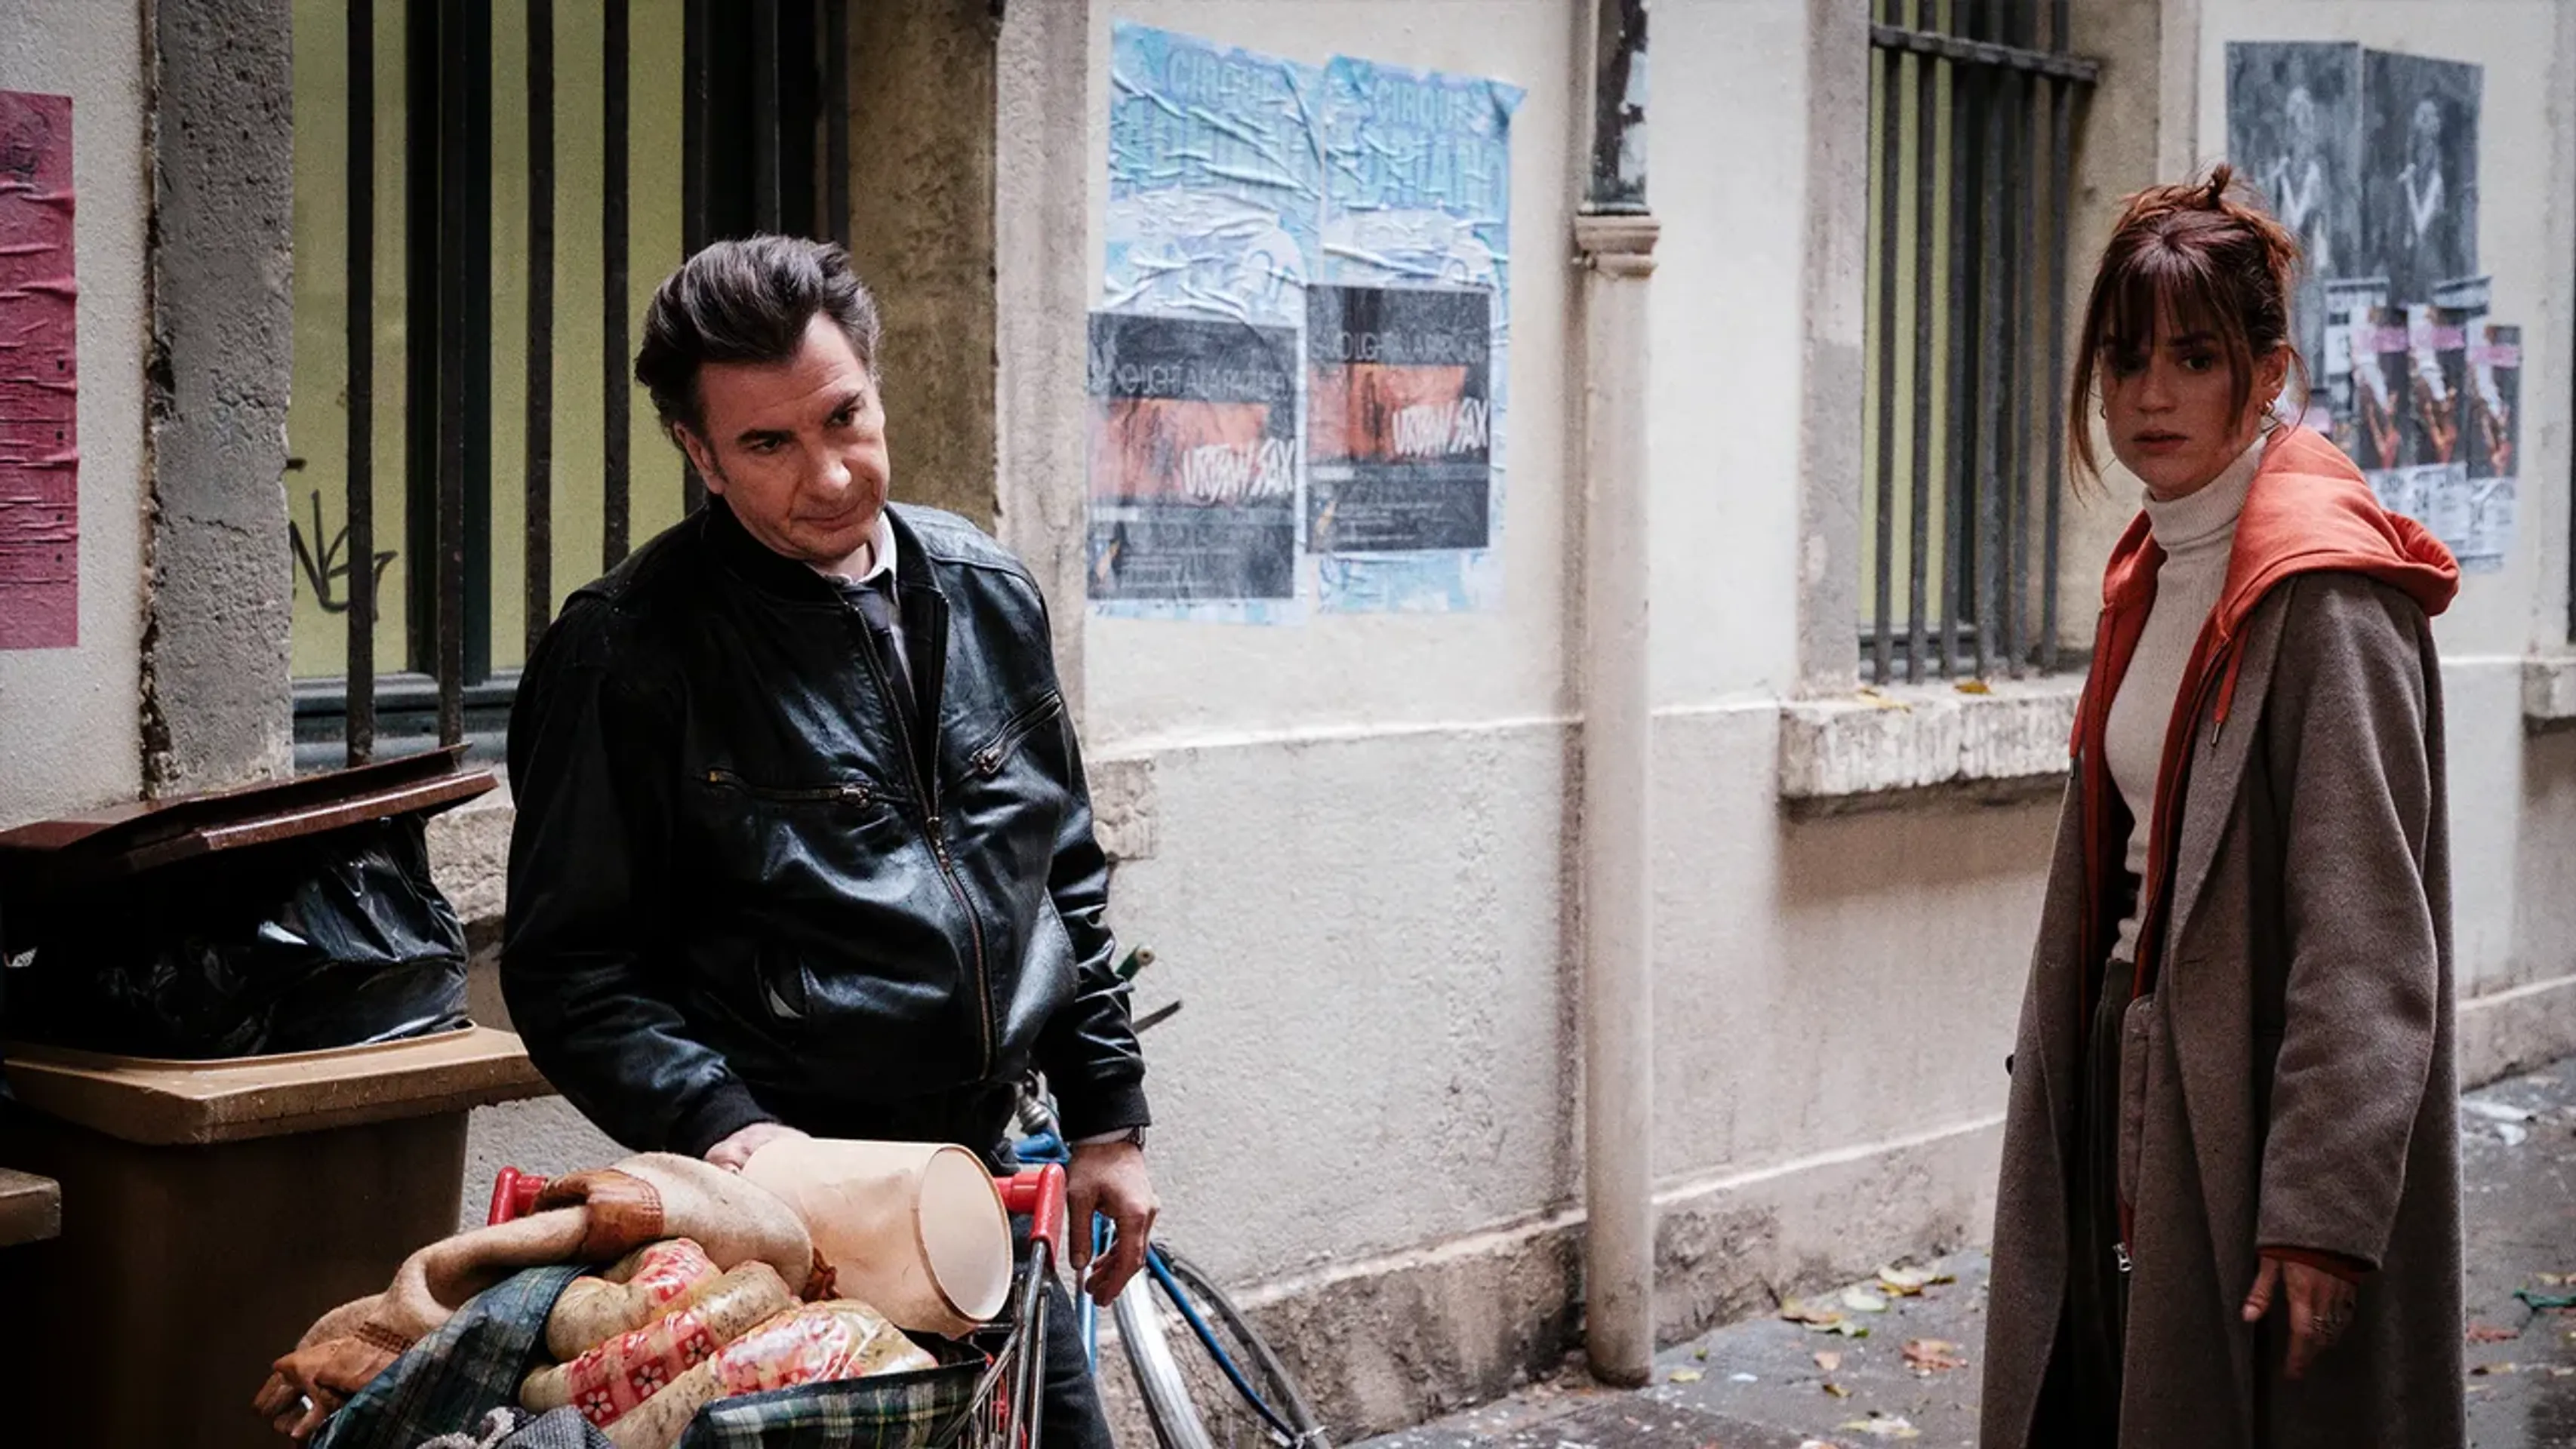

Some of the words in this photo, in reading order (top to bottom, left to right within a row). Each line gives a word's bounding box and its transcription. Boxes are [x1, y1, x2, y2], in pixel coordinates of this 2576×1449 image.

[1393, 400, 1457, 456] URBAN
[1450, 397, 1488, 453] SAX
[1183, 439, 1256, 503] URBAN
[1248, 437, 1295, 497] SAX
